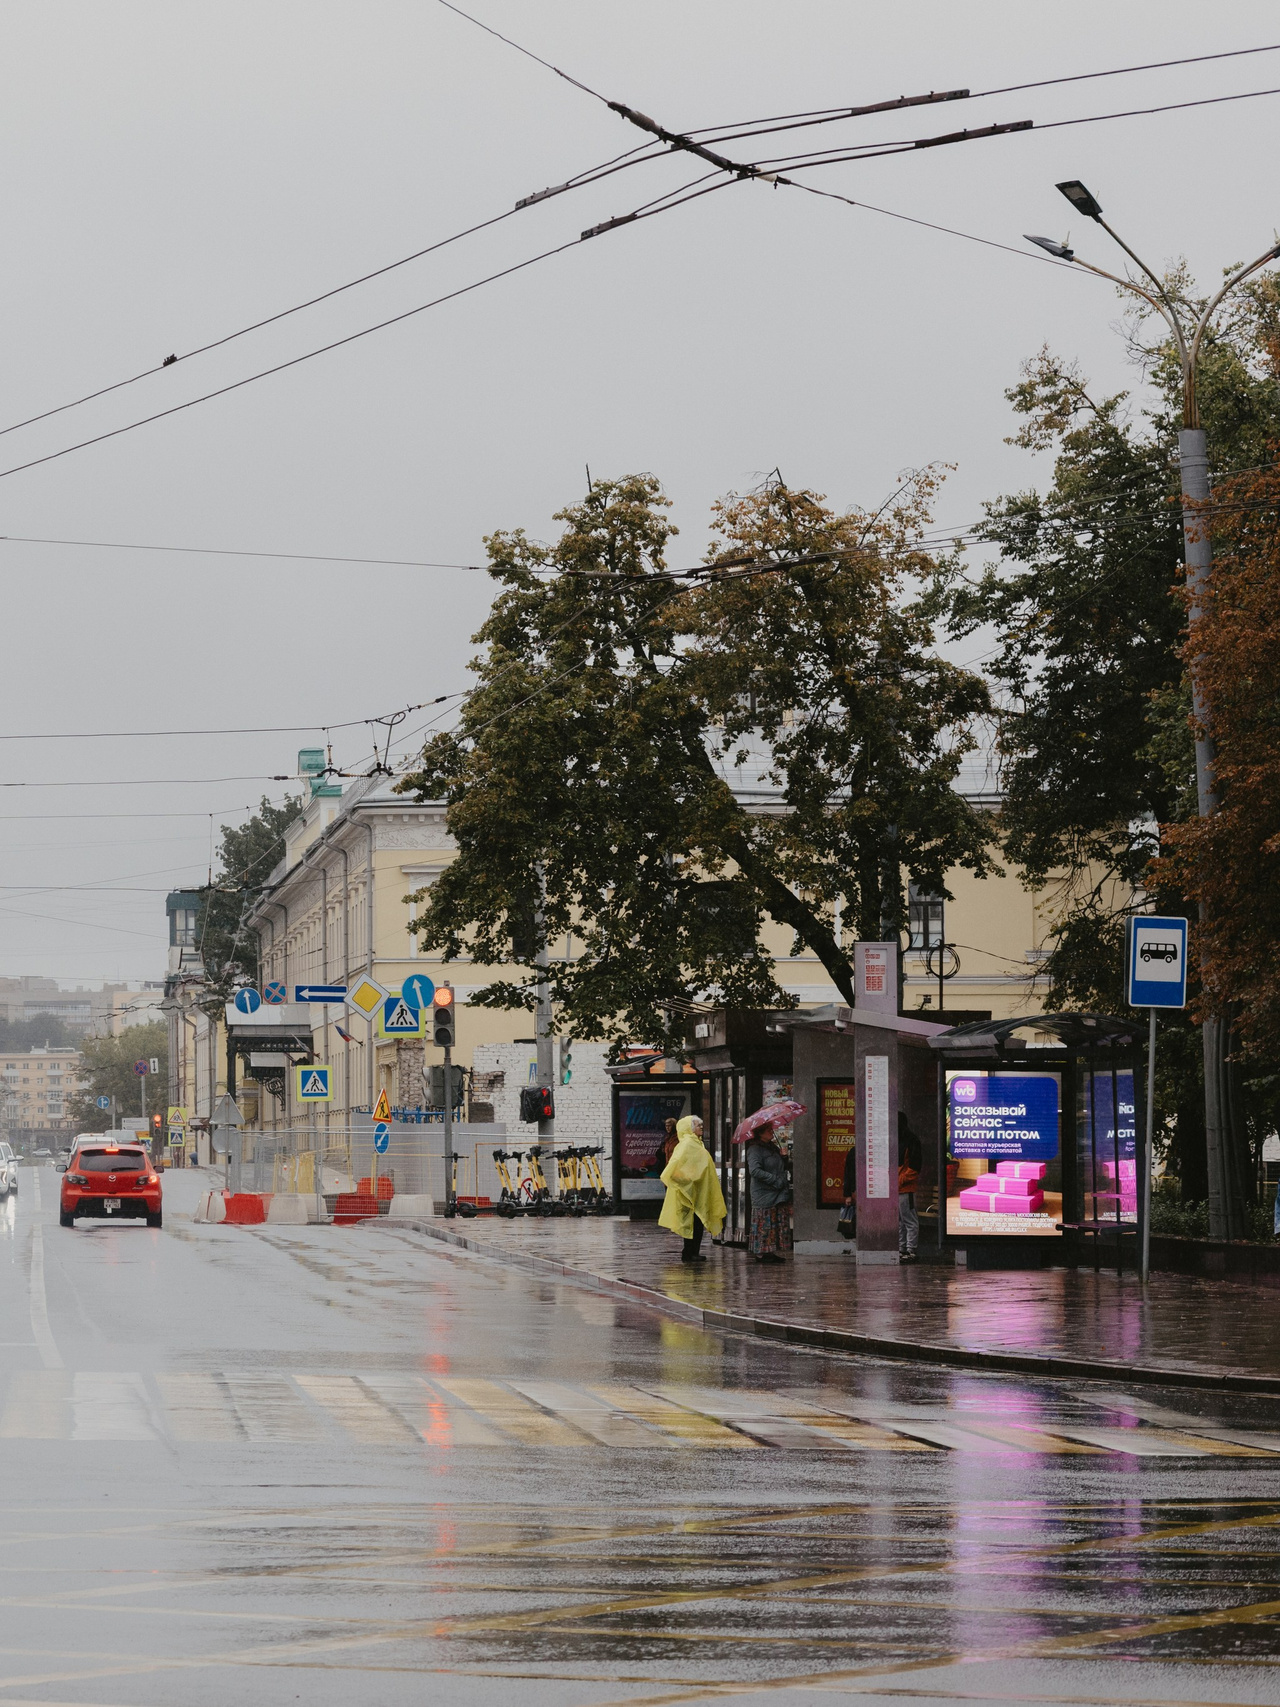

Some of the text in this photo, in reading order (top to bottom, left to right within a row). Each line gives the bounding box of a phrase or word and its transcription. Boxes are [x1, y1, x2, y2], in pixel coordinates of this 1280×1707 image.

[956, 1085, 974, 1096] wb
[954, 1104, 1026, 1116] заказывай
[954, 1116, 1002, 1127] сейчас
[954, 1130, 1040, 1139] плати потом
